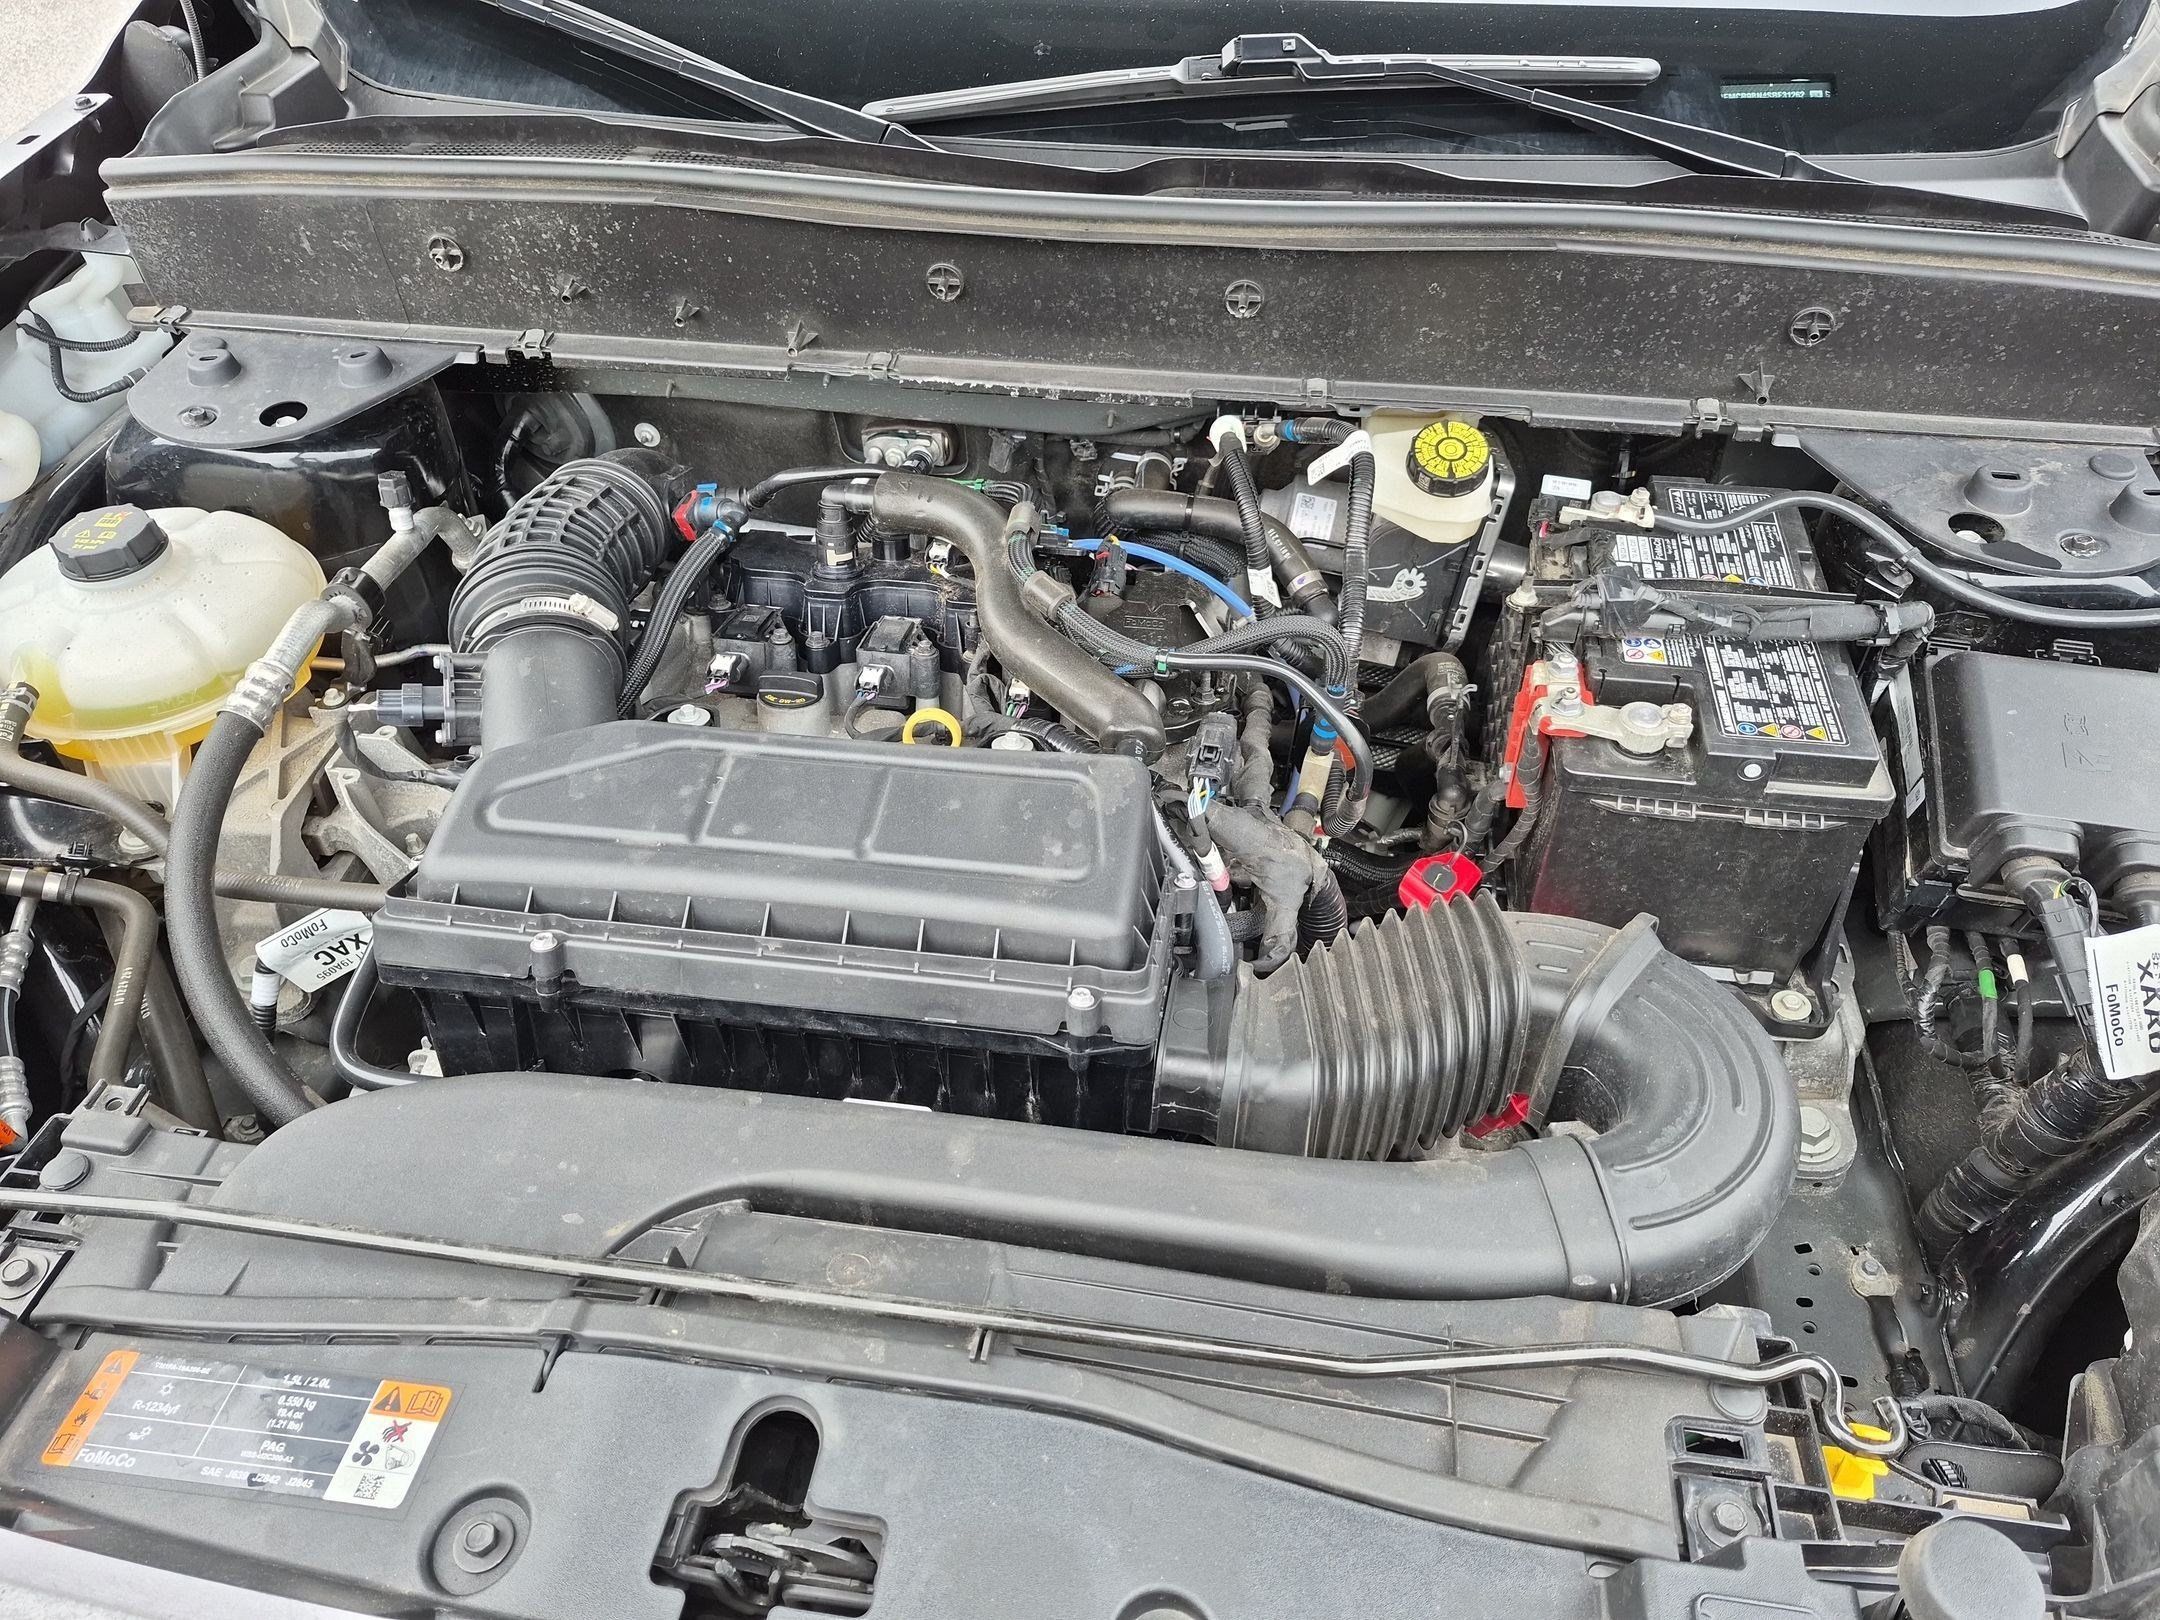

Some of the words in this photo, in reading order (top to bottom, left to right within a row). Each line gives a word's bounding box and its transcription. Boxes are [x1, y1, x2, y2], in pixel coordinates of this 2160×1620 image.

[281, 918, 328, 948] FoMoCo
[313, 932, 369, 967] XAC
[316, 957, 354, 981] 19A095
[2105, 984, 2124, 1046] FoMoCo
[283, 1373, 302, 1387] 1.5L
[311, 1377, 332, 1389] 2.0L
[132, 1399, 182, 1416] R-1234yf
[303, 1397, 318, 1412] kg
[260, 1439, 287, 1454] PAG
[75, 1447, 137, 1469] FoMoCo
[200, 1465, 224, 1478] SAE
